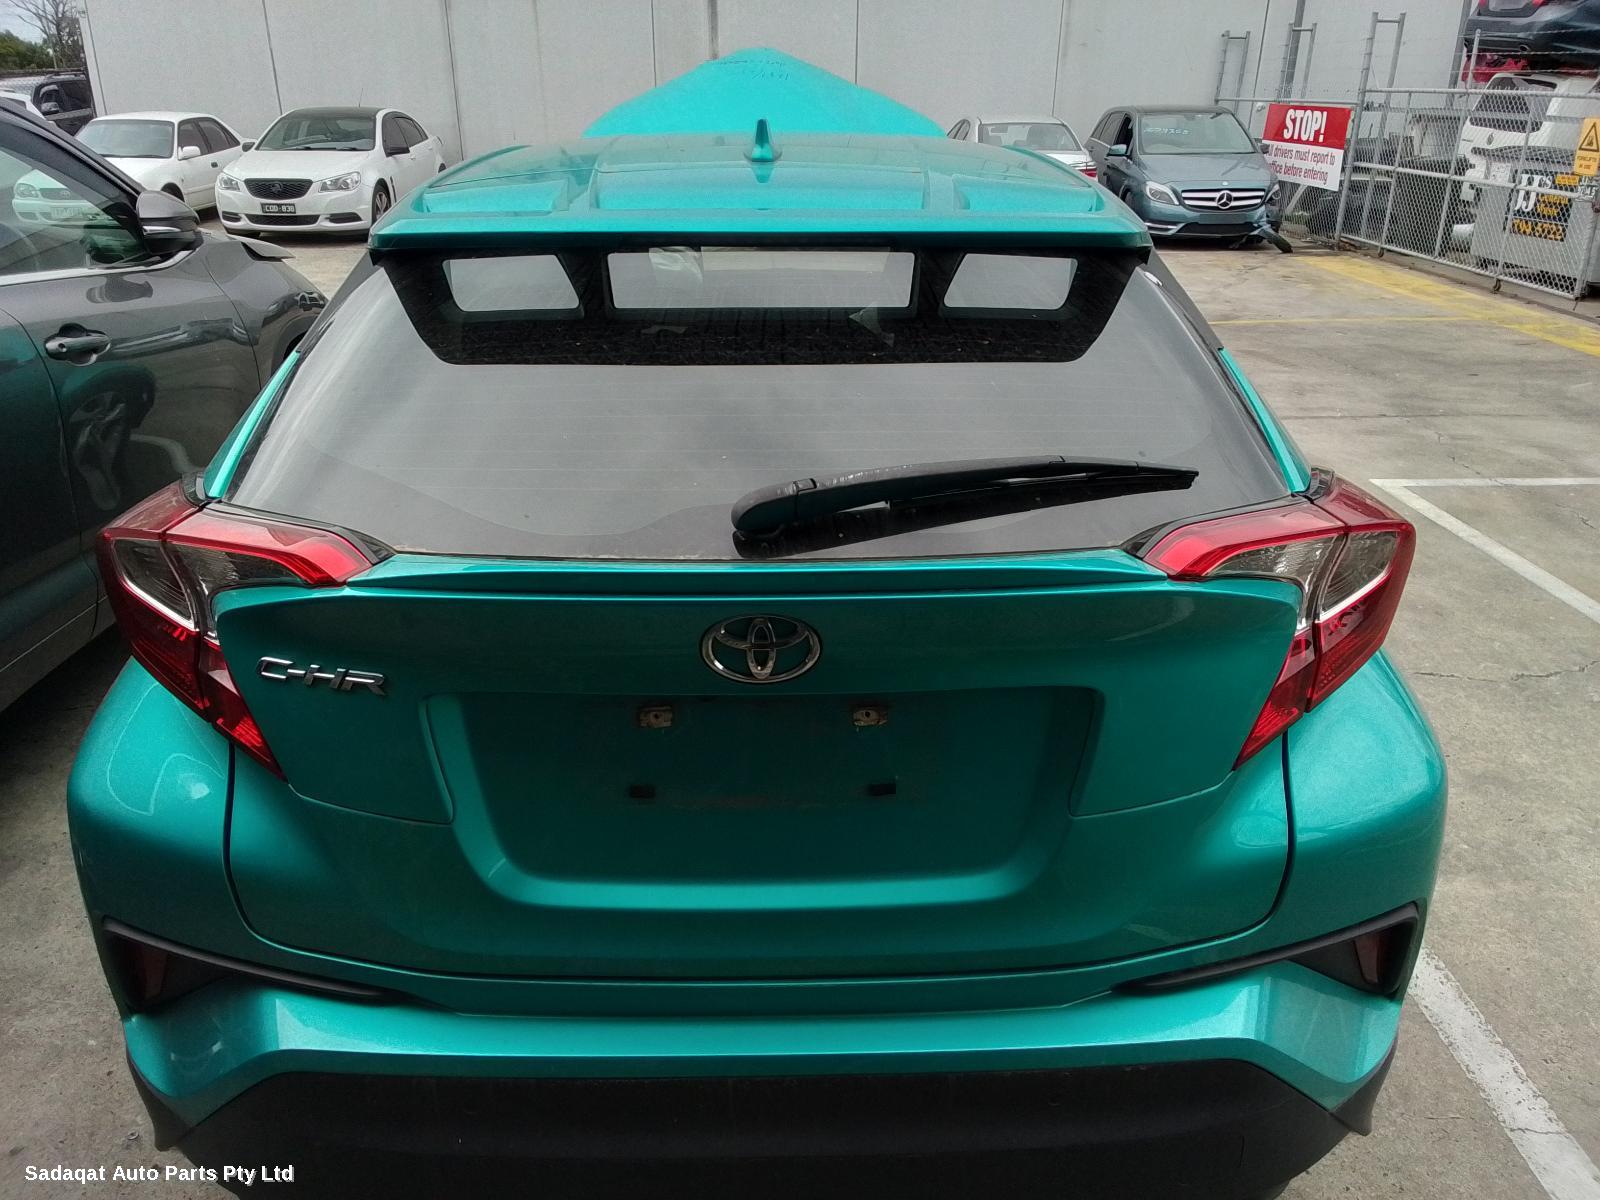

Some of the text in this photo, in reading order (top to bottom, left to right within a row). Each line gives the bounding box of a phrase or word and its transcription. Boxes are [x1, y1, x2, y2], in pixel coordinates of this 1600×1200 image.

[1283, 108, 1328, 143] STOP!
[1274, 145, 1293, 160] drivers
[1294, 149, 1310, 162] must
[1310, 152, 1329, 166] report
[1329, 153, 1336, 166] to
[1283, 162, 1303, 178] before
[1303, 167, 1329, 185] entering
[256, 656, 386, 696] C-HR
